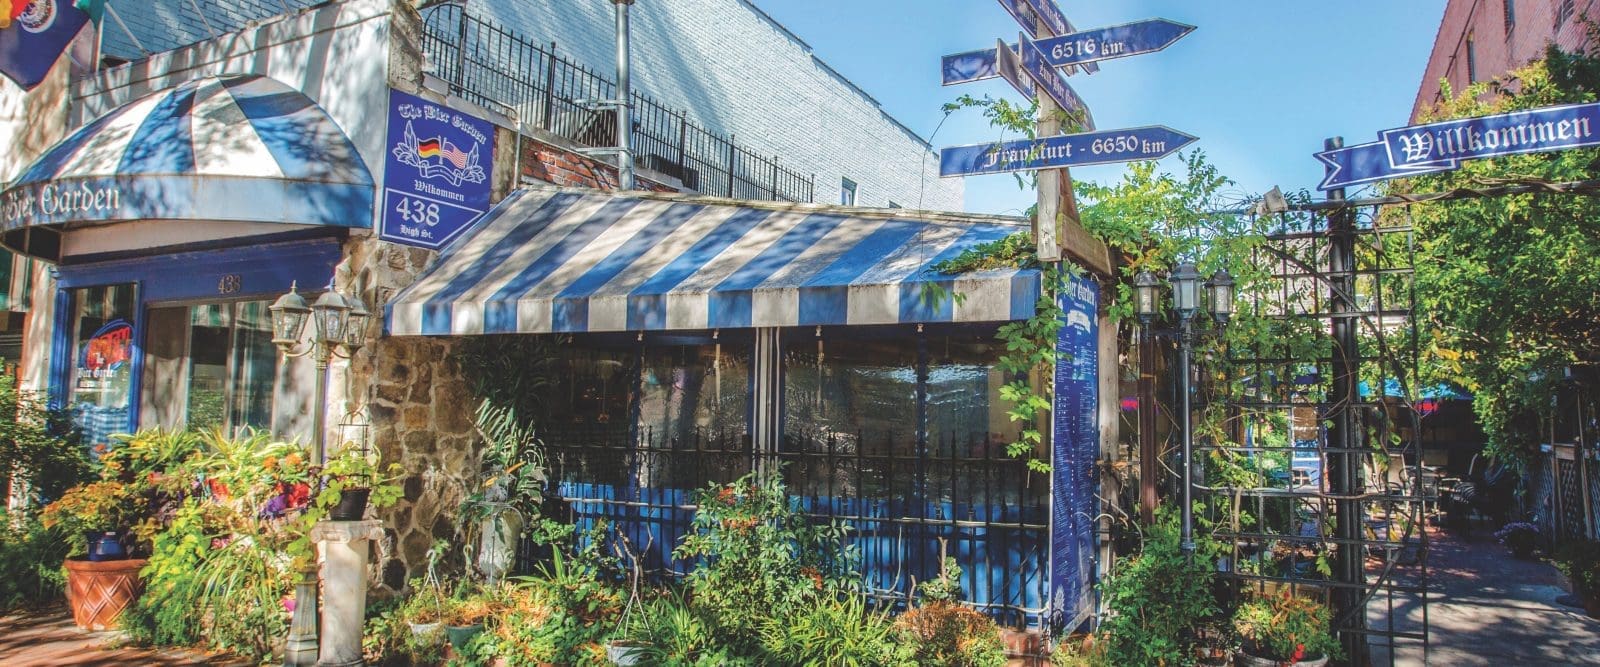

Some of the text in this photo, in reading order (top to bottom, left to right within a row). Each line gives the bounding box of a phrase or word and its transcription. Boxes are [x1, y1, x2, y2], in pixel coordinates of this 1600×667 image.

[1052, 39, 1124, 60] 6516 km
[398, 103, 487, 145] The Bier Garden
[1398, 115, 1592, 163] Willkommen
[982, 142, 1073, 168] Frankfurt
[1091, 135, 1138, 155] 6650
[1141, 139, 1166, 154] km
[41, 180, 120, 215] Garden
[414, 179, 465, 202] Wilkommen
[395, 196, 440, 227] 438
[400, 224, 434, 240] High St.
[217, 274, 241, 295] 438
